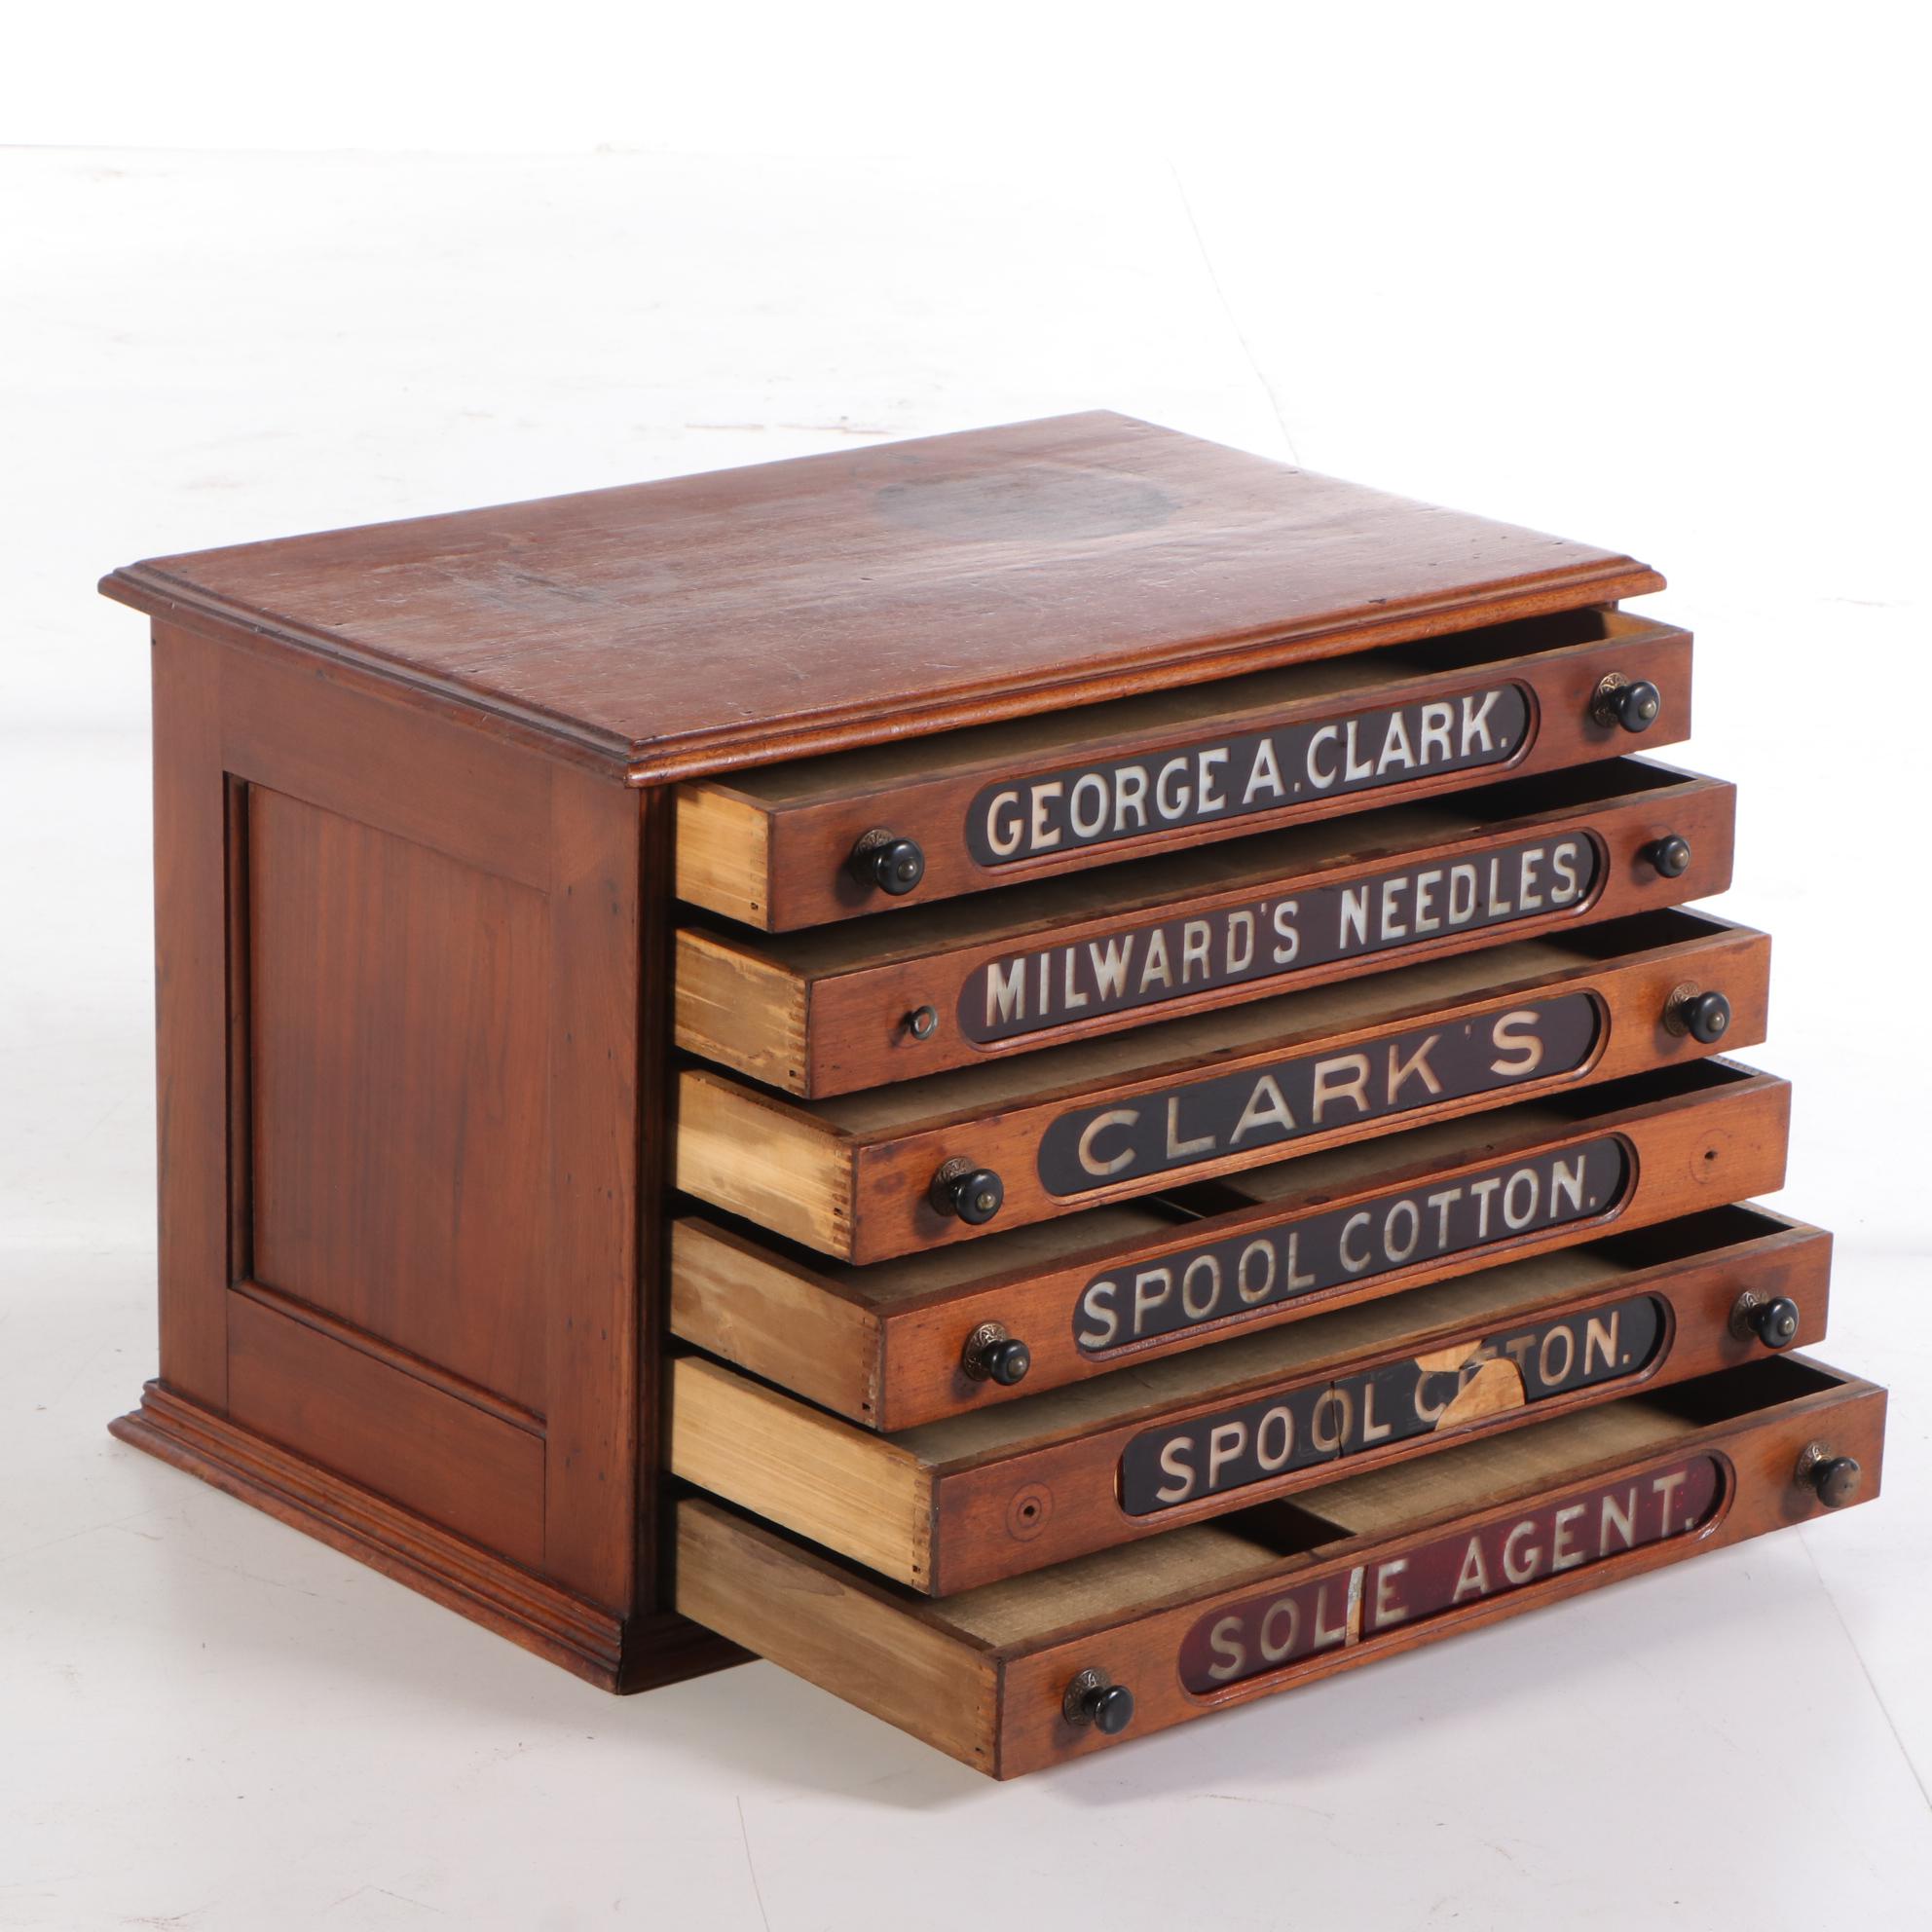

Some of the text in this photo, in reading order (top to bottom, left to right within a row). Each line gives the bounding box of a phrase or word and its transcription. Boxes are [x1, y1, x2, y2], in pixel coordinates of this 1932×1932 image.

[985, 747, 1230, 857] GEORGE
[985, 841, 1585, 1028] MILWARD'S NEEDLES.
[1078, 1155, 1597, 1348] SPOOL COTTON.
[1156, 1310, 1631, 1504] SPOOL CTON.
[1207, 1470, 1695, 1680] SOLE AGENT.
